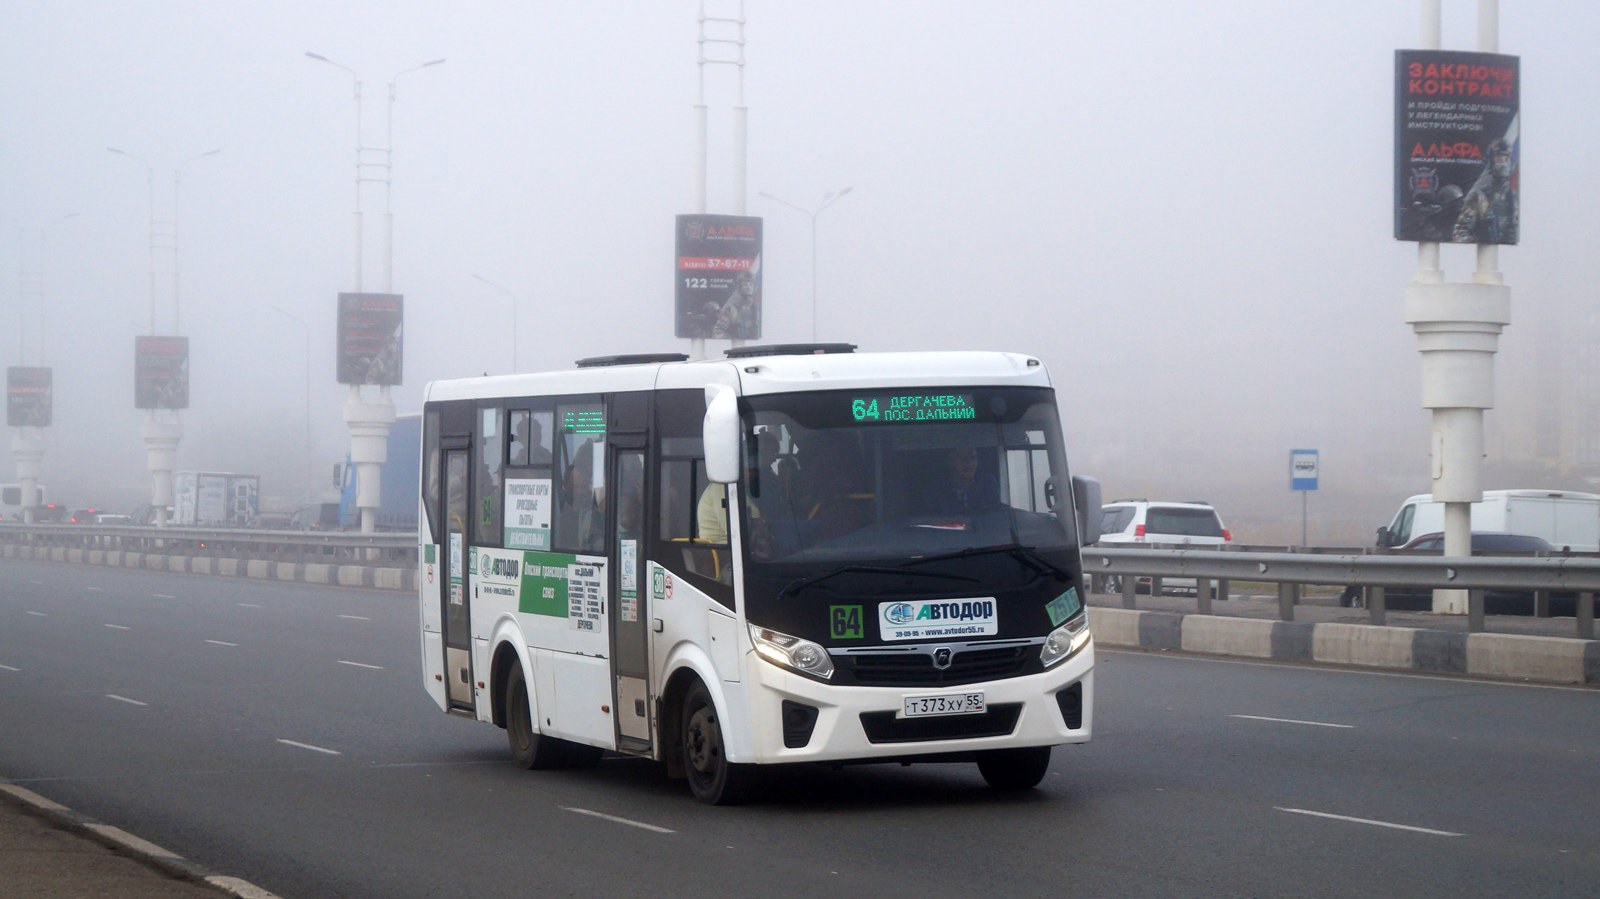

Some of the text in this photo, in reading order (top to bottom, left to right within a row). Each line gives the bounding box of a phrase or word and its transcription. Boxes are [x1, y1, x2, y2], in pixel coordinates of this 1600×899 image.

[1408, 62, 1514, 82] ЗАКЛЮЧИ
[1408, 79, 1513, 98] КОНТРАКТ
[1417, 101, 1456, 110] ПРОЙДИ
[1408, 111, 1415, 119] У
[1411, 142, 1483, 158] АЛЬФА
[707, 258, 750, 268] 37-67-11
[684, 277, 708, 289] 122
[890, 395, 965, 409] ДЕРГАЧЕВА
[852, 399, 879, 420] 64
[655, 573, 664, 593] 30
[832, 607, 861, 636] 64
[924, 626, 985, 637] www.avtodor55.ru
[966, 695, 980, 706] 55
